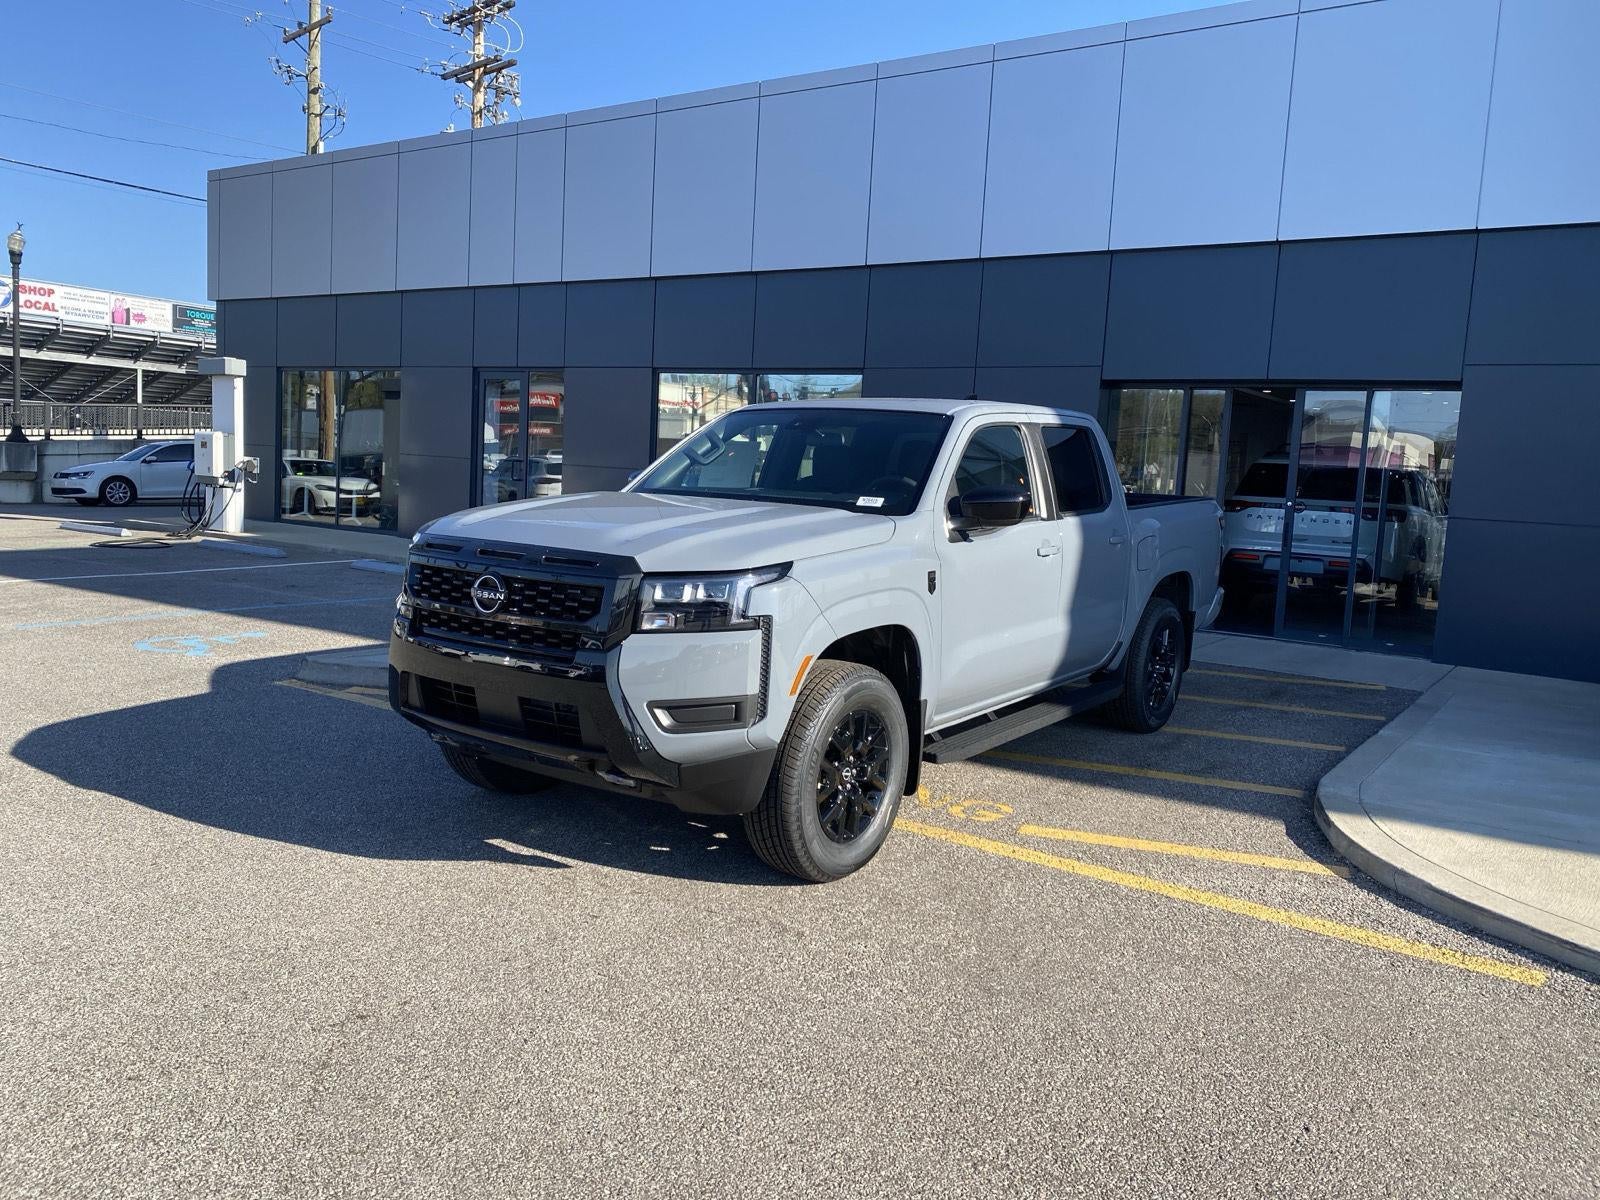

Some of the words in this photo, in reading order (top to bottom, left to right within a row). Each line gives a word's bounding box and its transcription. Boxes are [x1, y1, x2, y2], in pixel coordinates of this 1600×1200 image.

[18, 284, 55, 297] SHOP
[187, 310, 215, 320] TORQUE
[1246, 513, 1352, 525] PATHINDER
